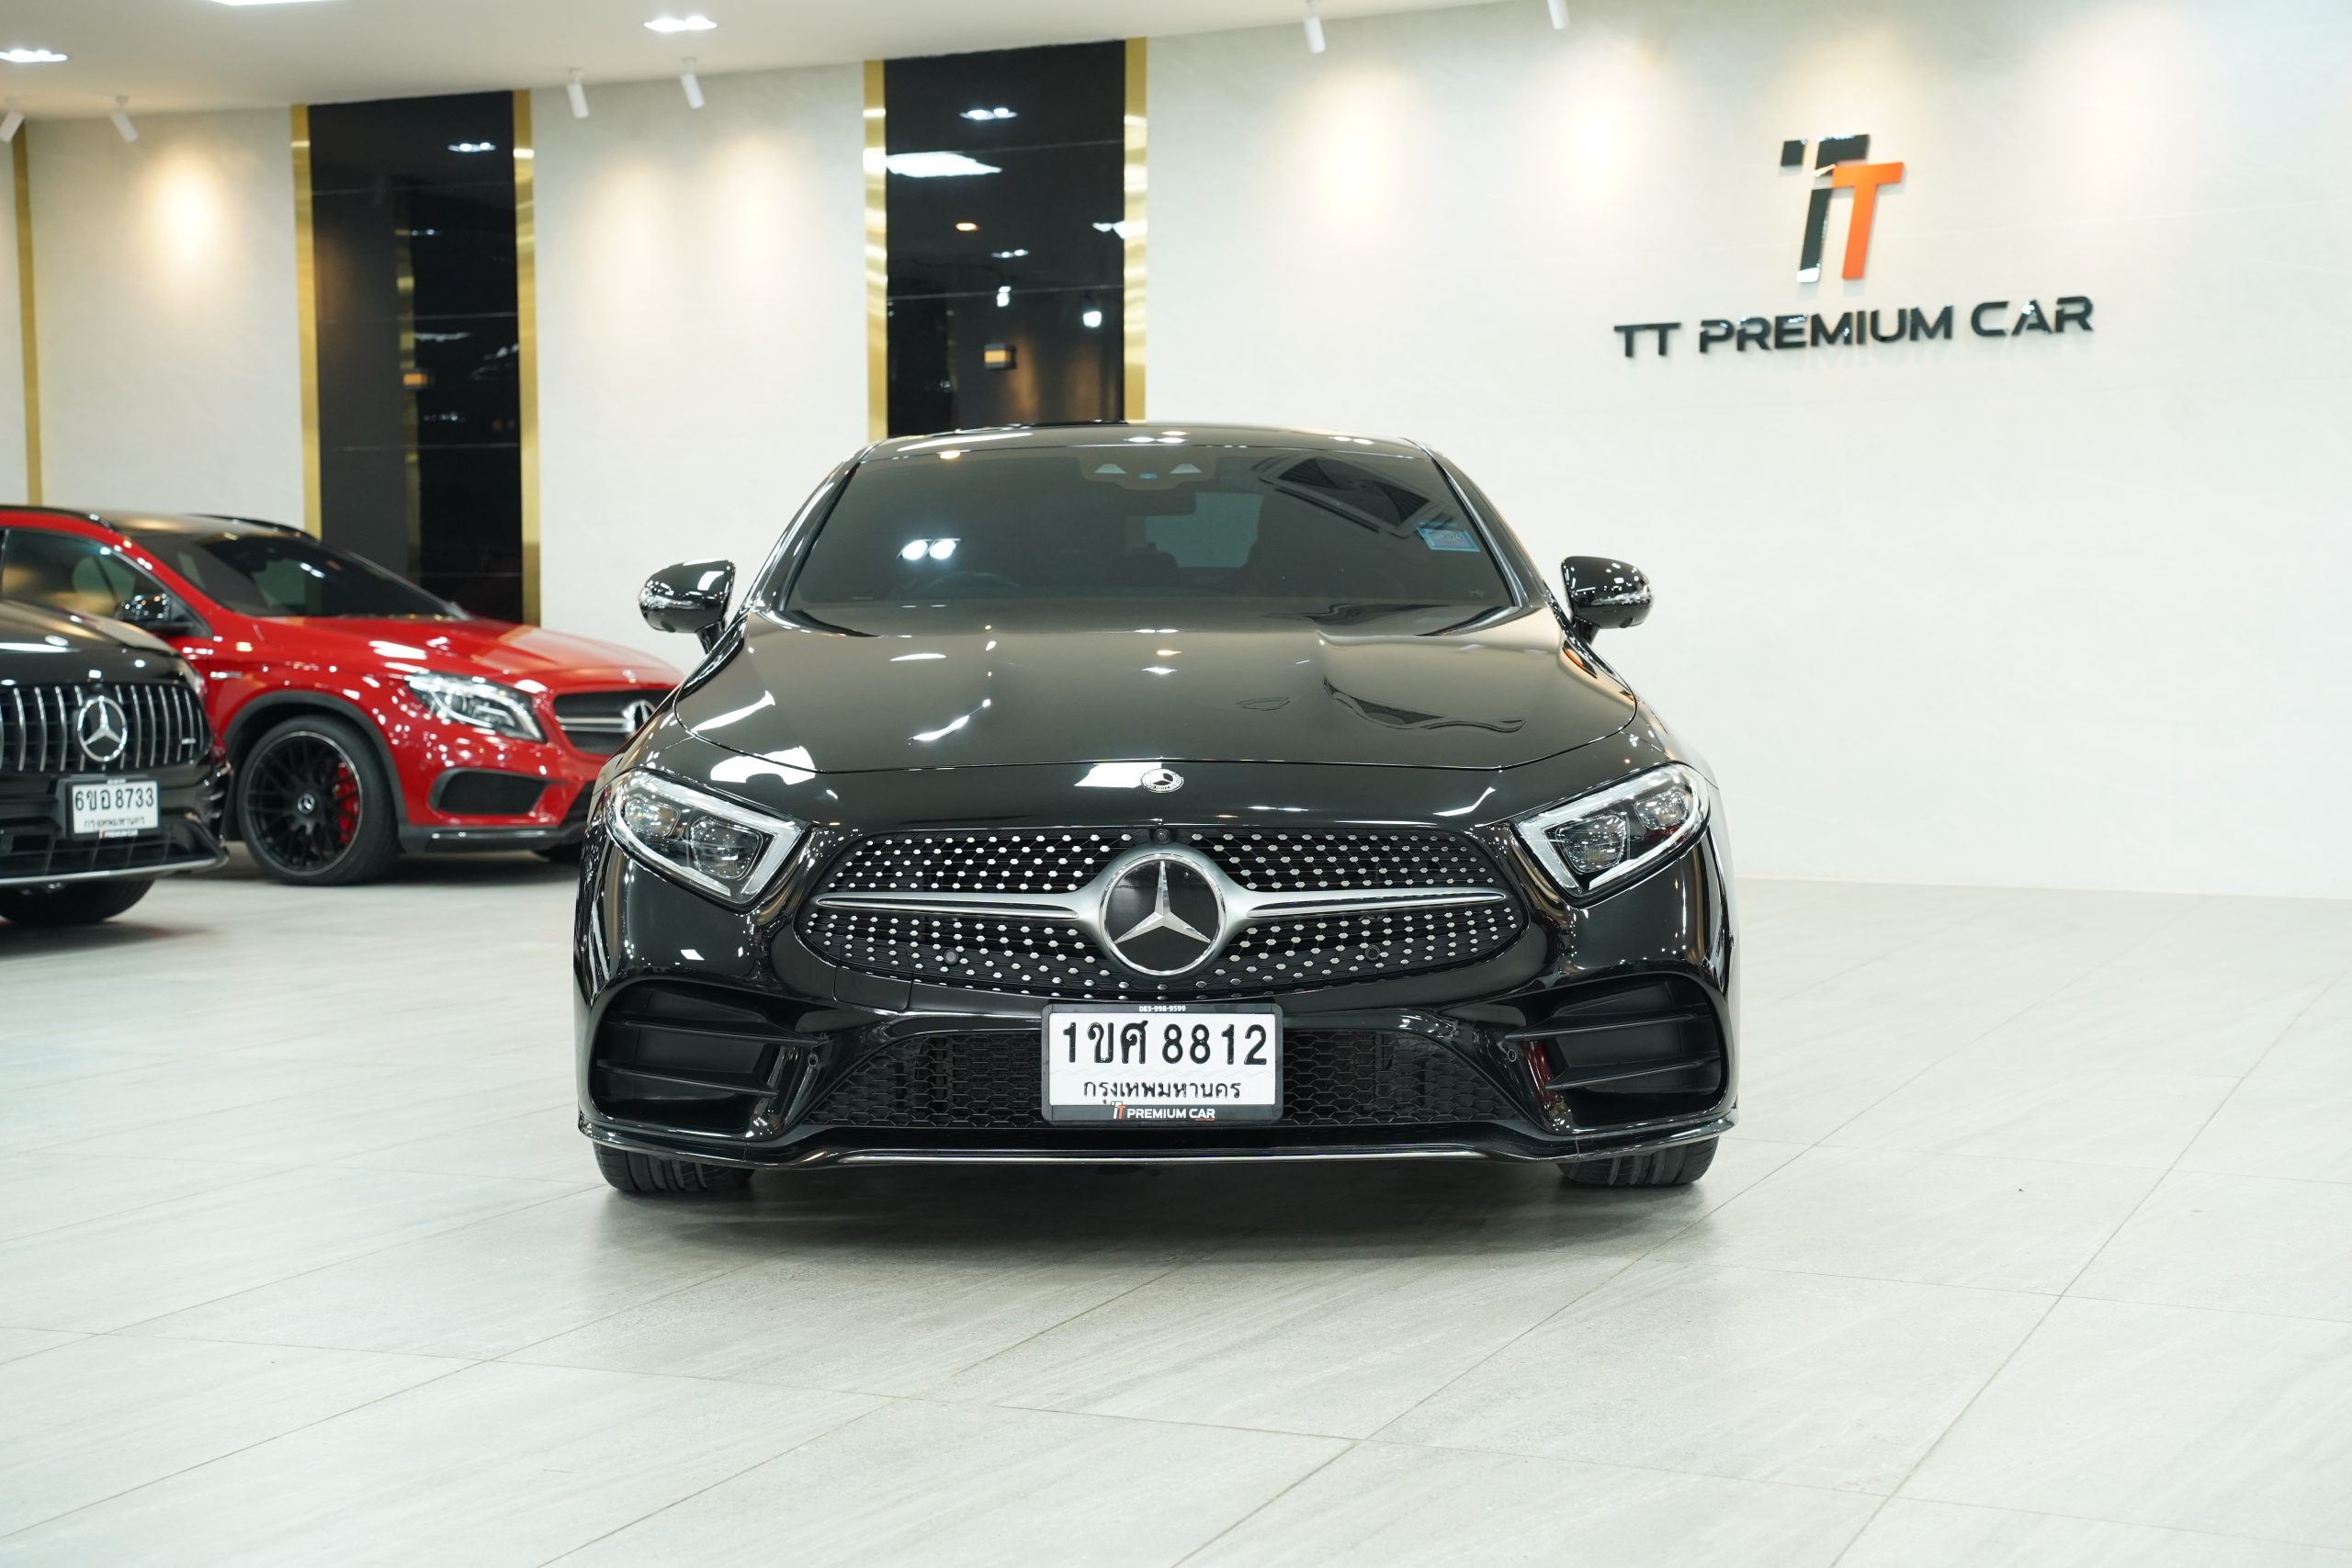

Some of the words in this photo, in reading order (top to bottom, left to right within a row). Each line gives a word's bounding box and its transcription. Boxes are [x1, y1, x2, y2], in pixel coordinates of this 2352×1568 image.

[1613, 321, 1681, 357] TT
[1699, 305, 1954, 354] PREMIUM
[1970, 295, 2095, 337] CAR
[115, 787, 154, 809] 8733
[1062, 1020, 1149, 1065] 1ขศ
[1161, 1023, 1268, 1066] 8812
[1083, 1080, 1242, 1104] กรุงเทพมหานคร
[1126, 1108, 1187, 1119] PREMIUM
[1188, 1108, 1216, 1119] CAR
